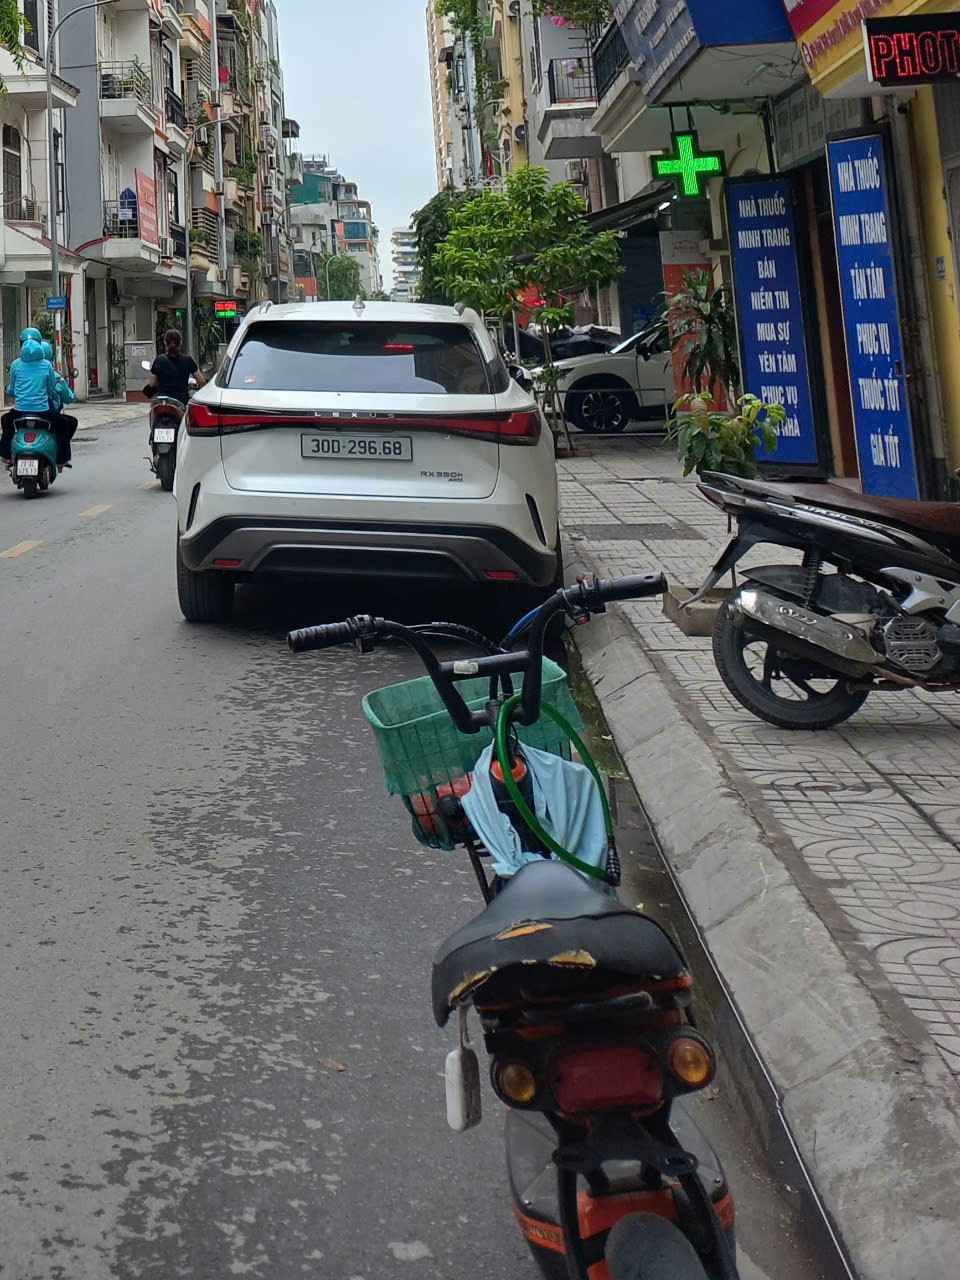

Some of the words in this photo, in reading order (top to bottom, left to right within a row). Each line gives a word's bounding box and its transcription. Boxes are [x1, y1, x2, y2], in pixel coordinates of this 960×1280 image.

[871, 29, 960, 78] PHOT
[837, 154, 855, 192] NHÀ
[854, 147, 880, 190] THUỐC
[738, 195, 757, 218] NHÀ
[758, 190, 786, 217] THUỐC
[738, 229, 761, 249] MINH
[762, 227, 791, 247] TRANG
[839, 214, 861, 246] MINH
[859, 211, 887, 244] TRANG
[758, 256, 777, 279] BÁN
[850, 261, 867, 307] TẬN
[866, 260, 886, 300] TÂM
[774, 290, 790, 310] TIN
[756, 322, 777, 342] MUA
[777, 320, 790, 345] SỰ
[856, 323, 879, 362] PHỤC
[878, 322, 890, 362] VỤ
[758, 350, 777, 373] YÊN
[777, 349, 797, 373] TÂM
[785, 385, 799, 409] VỤ
[858, 367, 885, 411] THUỐC
[884, 367, 900, 412] TỐT
[314, 411, 395, 419] LEXUS
[311, 438, 402, 456] 30D-296.68
[870, 427, 886, 467] GIÁ
[884, 423, 900, 468] TỐT
